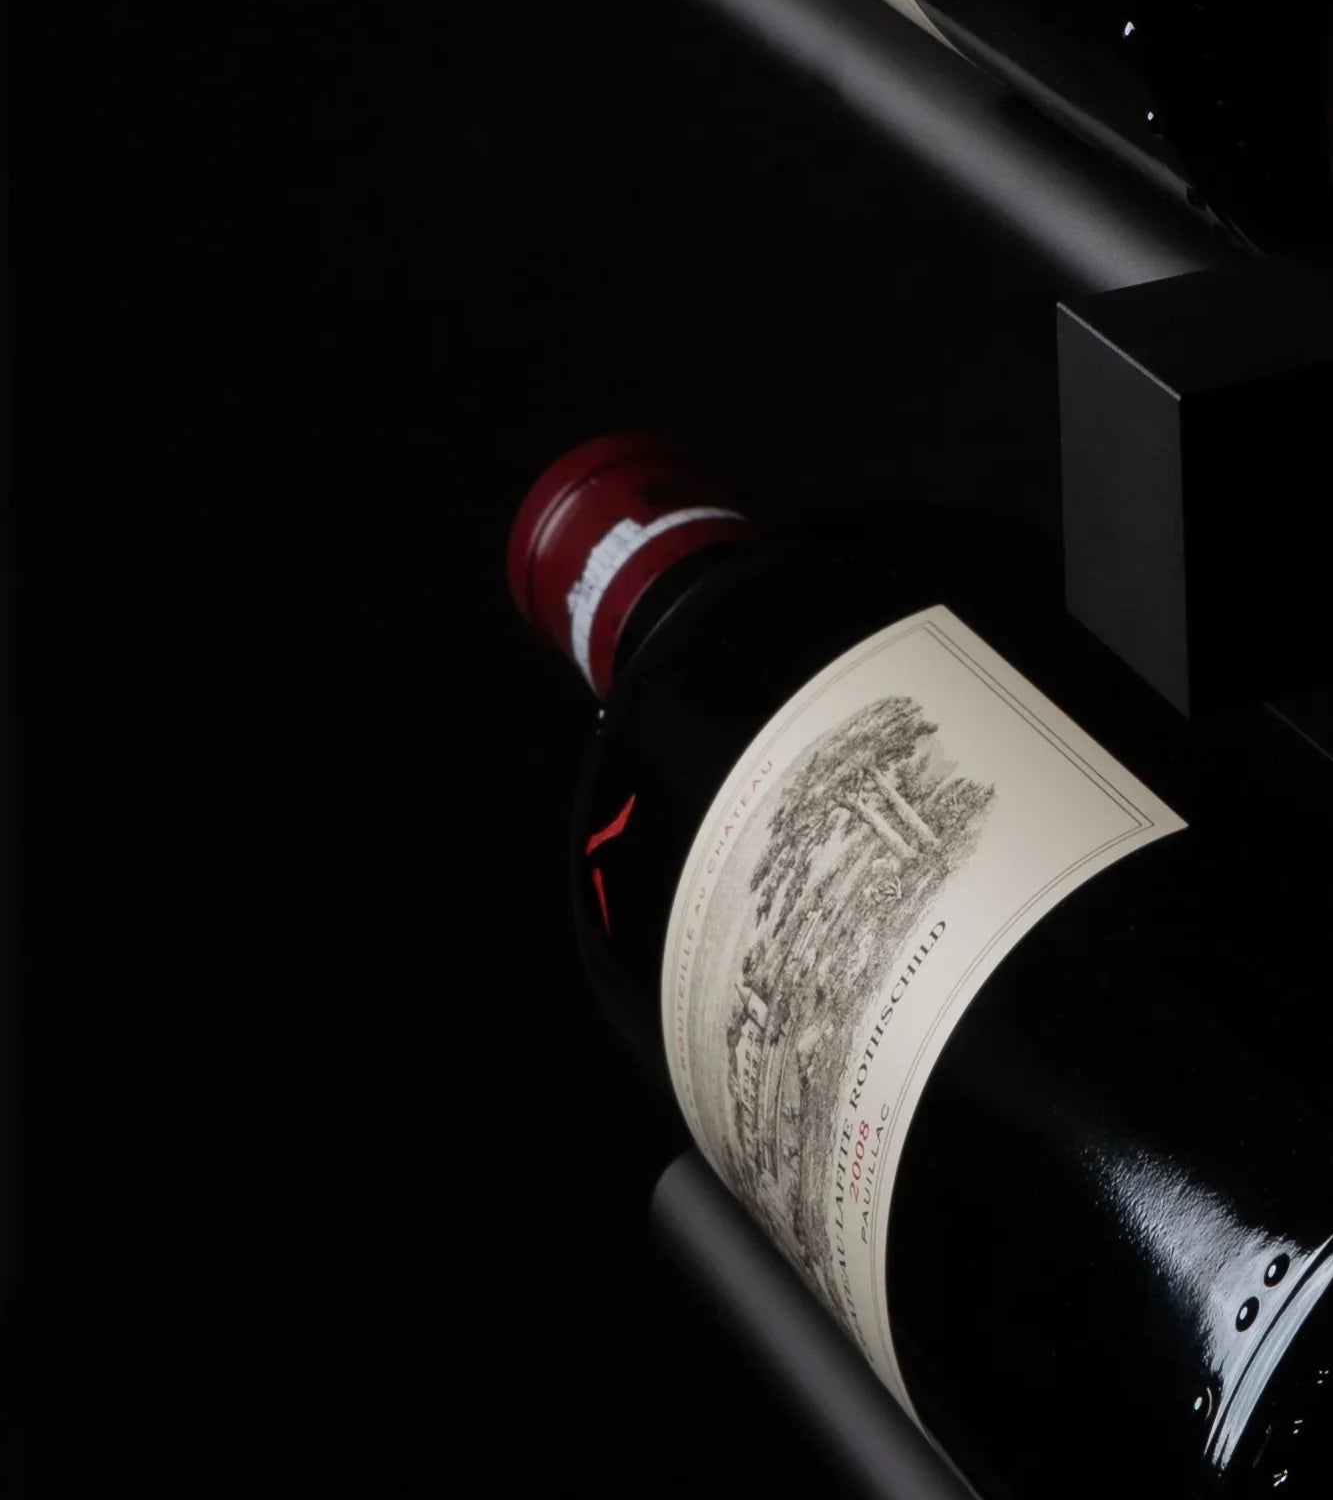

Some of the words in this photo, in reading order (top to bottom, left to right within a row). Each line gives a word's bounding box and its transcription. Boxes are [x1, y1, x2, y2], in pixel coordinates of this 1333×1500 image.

[835, 1117, 854, 1231] LAFITE
[849, 920, 947, 1111] ROTHSCHILD
[849, 1119, 871, 1204] 2008
[860, 1102, 891, 1245] PAUILLAC
